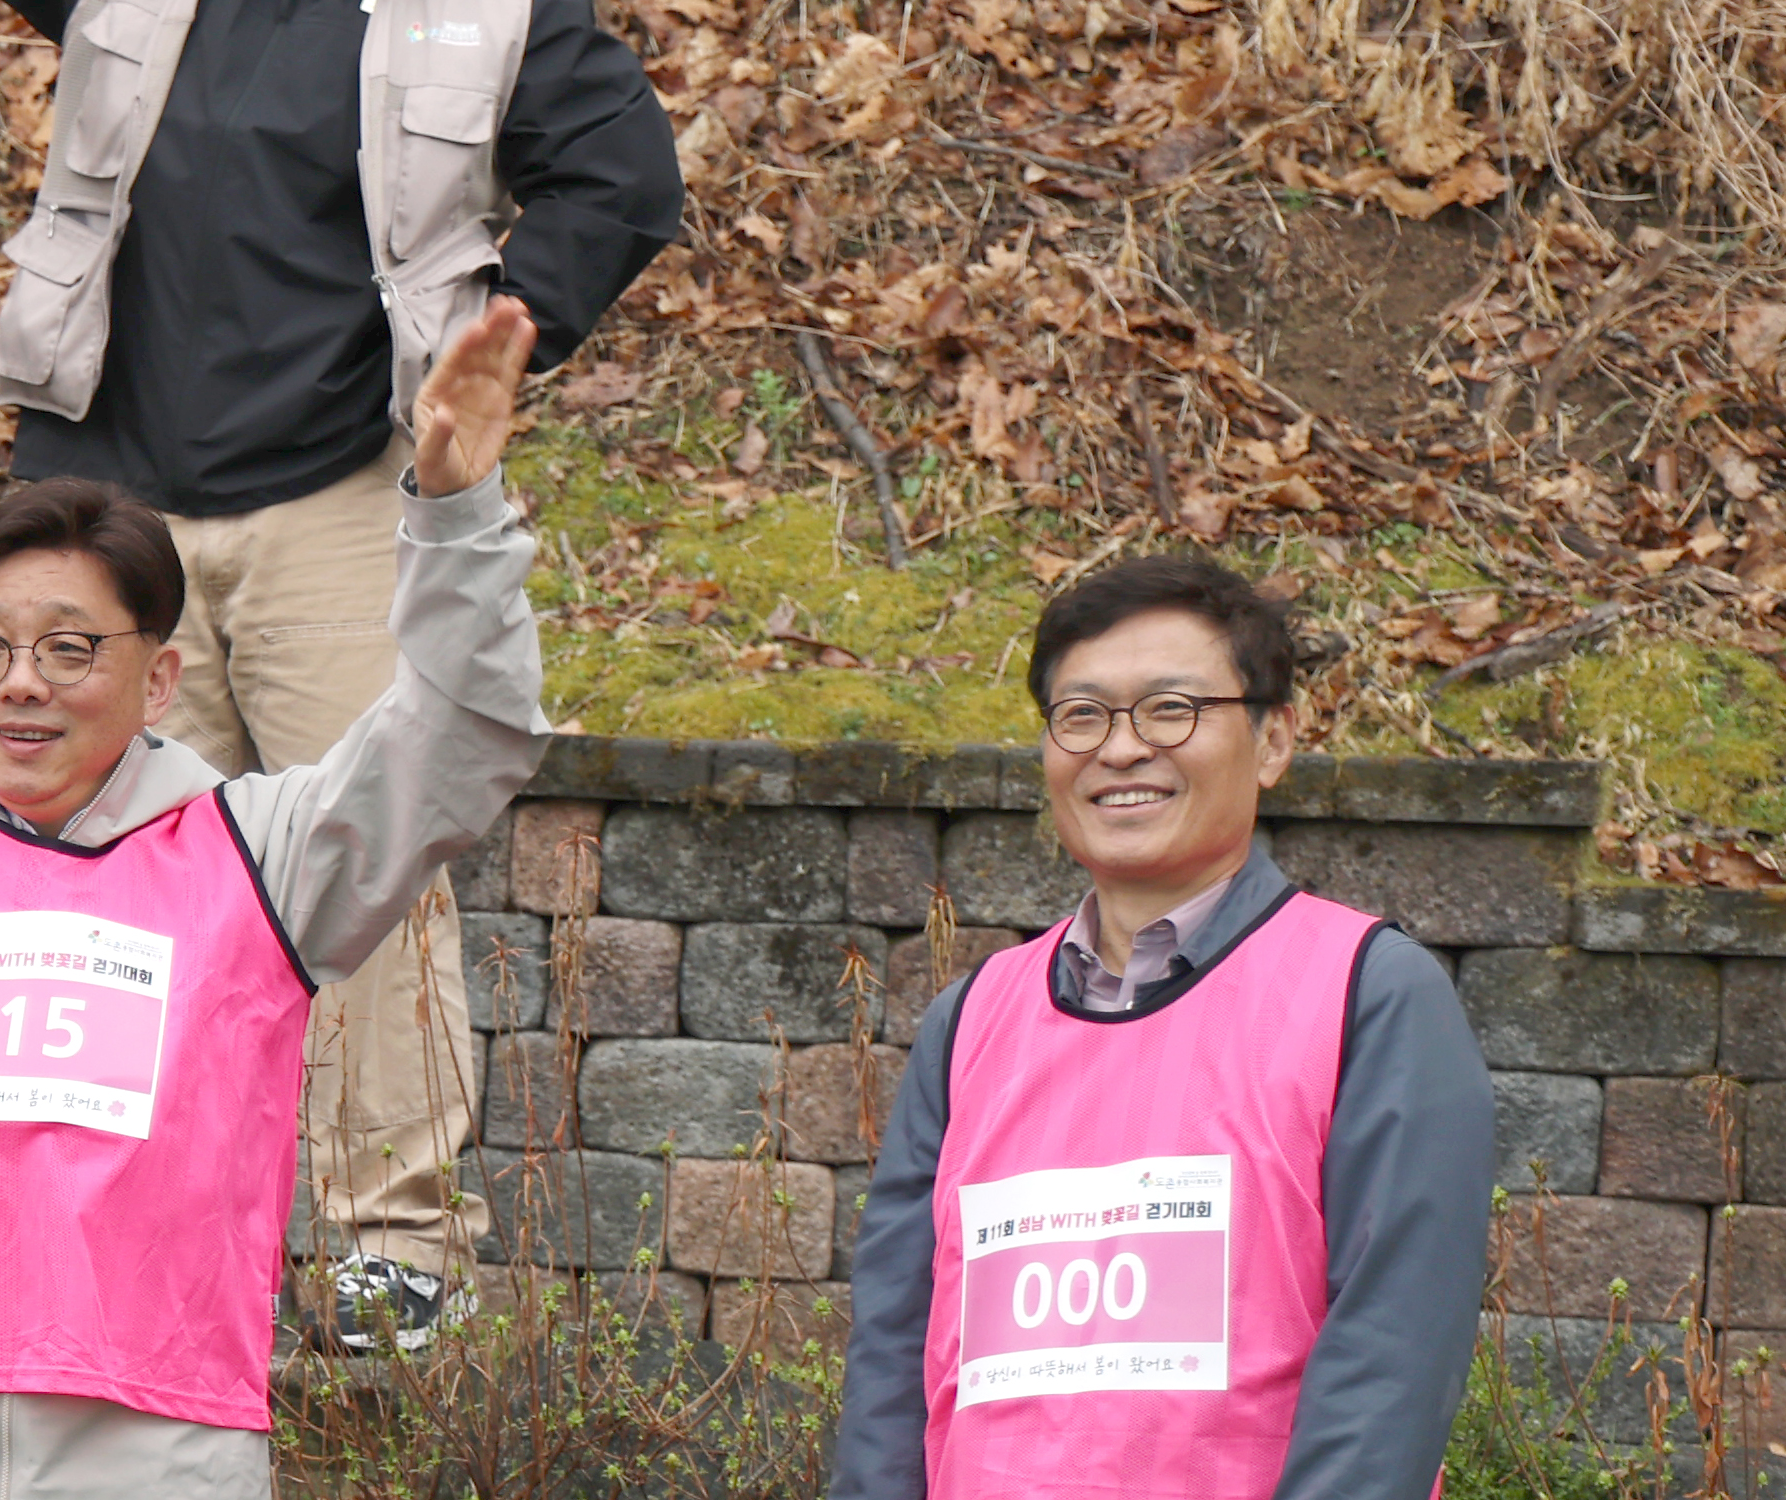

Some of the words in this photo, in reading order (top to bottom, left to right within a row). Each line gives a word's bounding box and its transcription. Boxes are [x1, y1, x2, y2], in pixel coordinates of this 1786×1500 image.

[41, 953, 86, 970] 벚꽃길
[92, 958, 152, 985] 걷기대회
[28, 1089, 52, 1107] 봄이
[62, 1094, 102, 1111] 왔어요
[976, 1228, 987, 1245] 제
[991, 1220, 1014, 1239] 11회
[1018, 1216, 1045, 1234] 성남
[1050, 1212, 1096, 1228] WITH
[1101, 1204, 1139, 1226] 벚꽃길
[1146, 1201, 1212, 1220] 걷기대회
[1013, 1252, 1147, 1329] 000
[986, 1367, 1021, 1383] 당신이
[1030, 1360, 1086, 1376] 따뜻해서
[1095, 1356, 1118, 1374] 봄이
[1129, 1356, 1173, 1374] 왔어요
